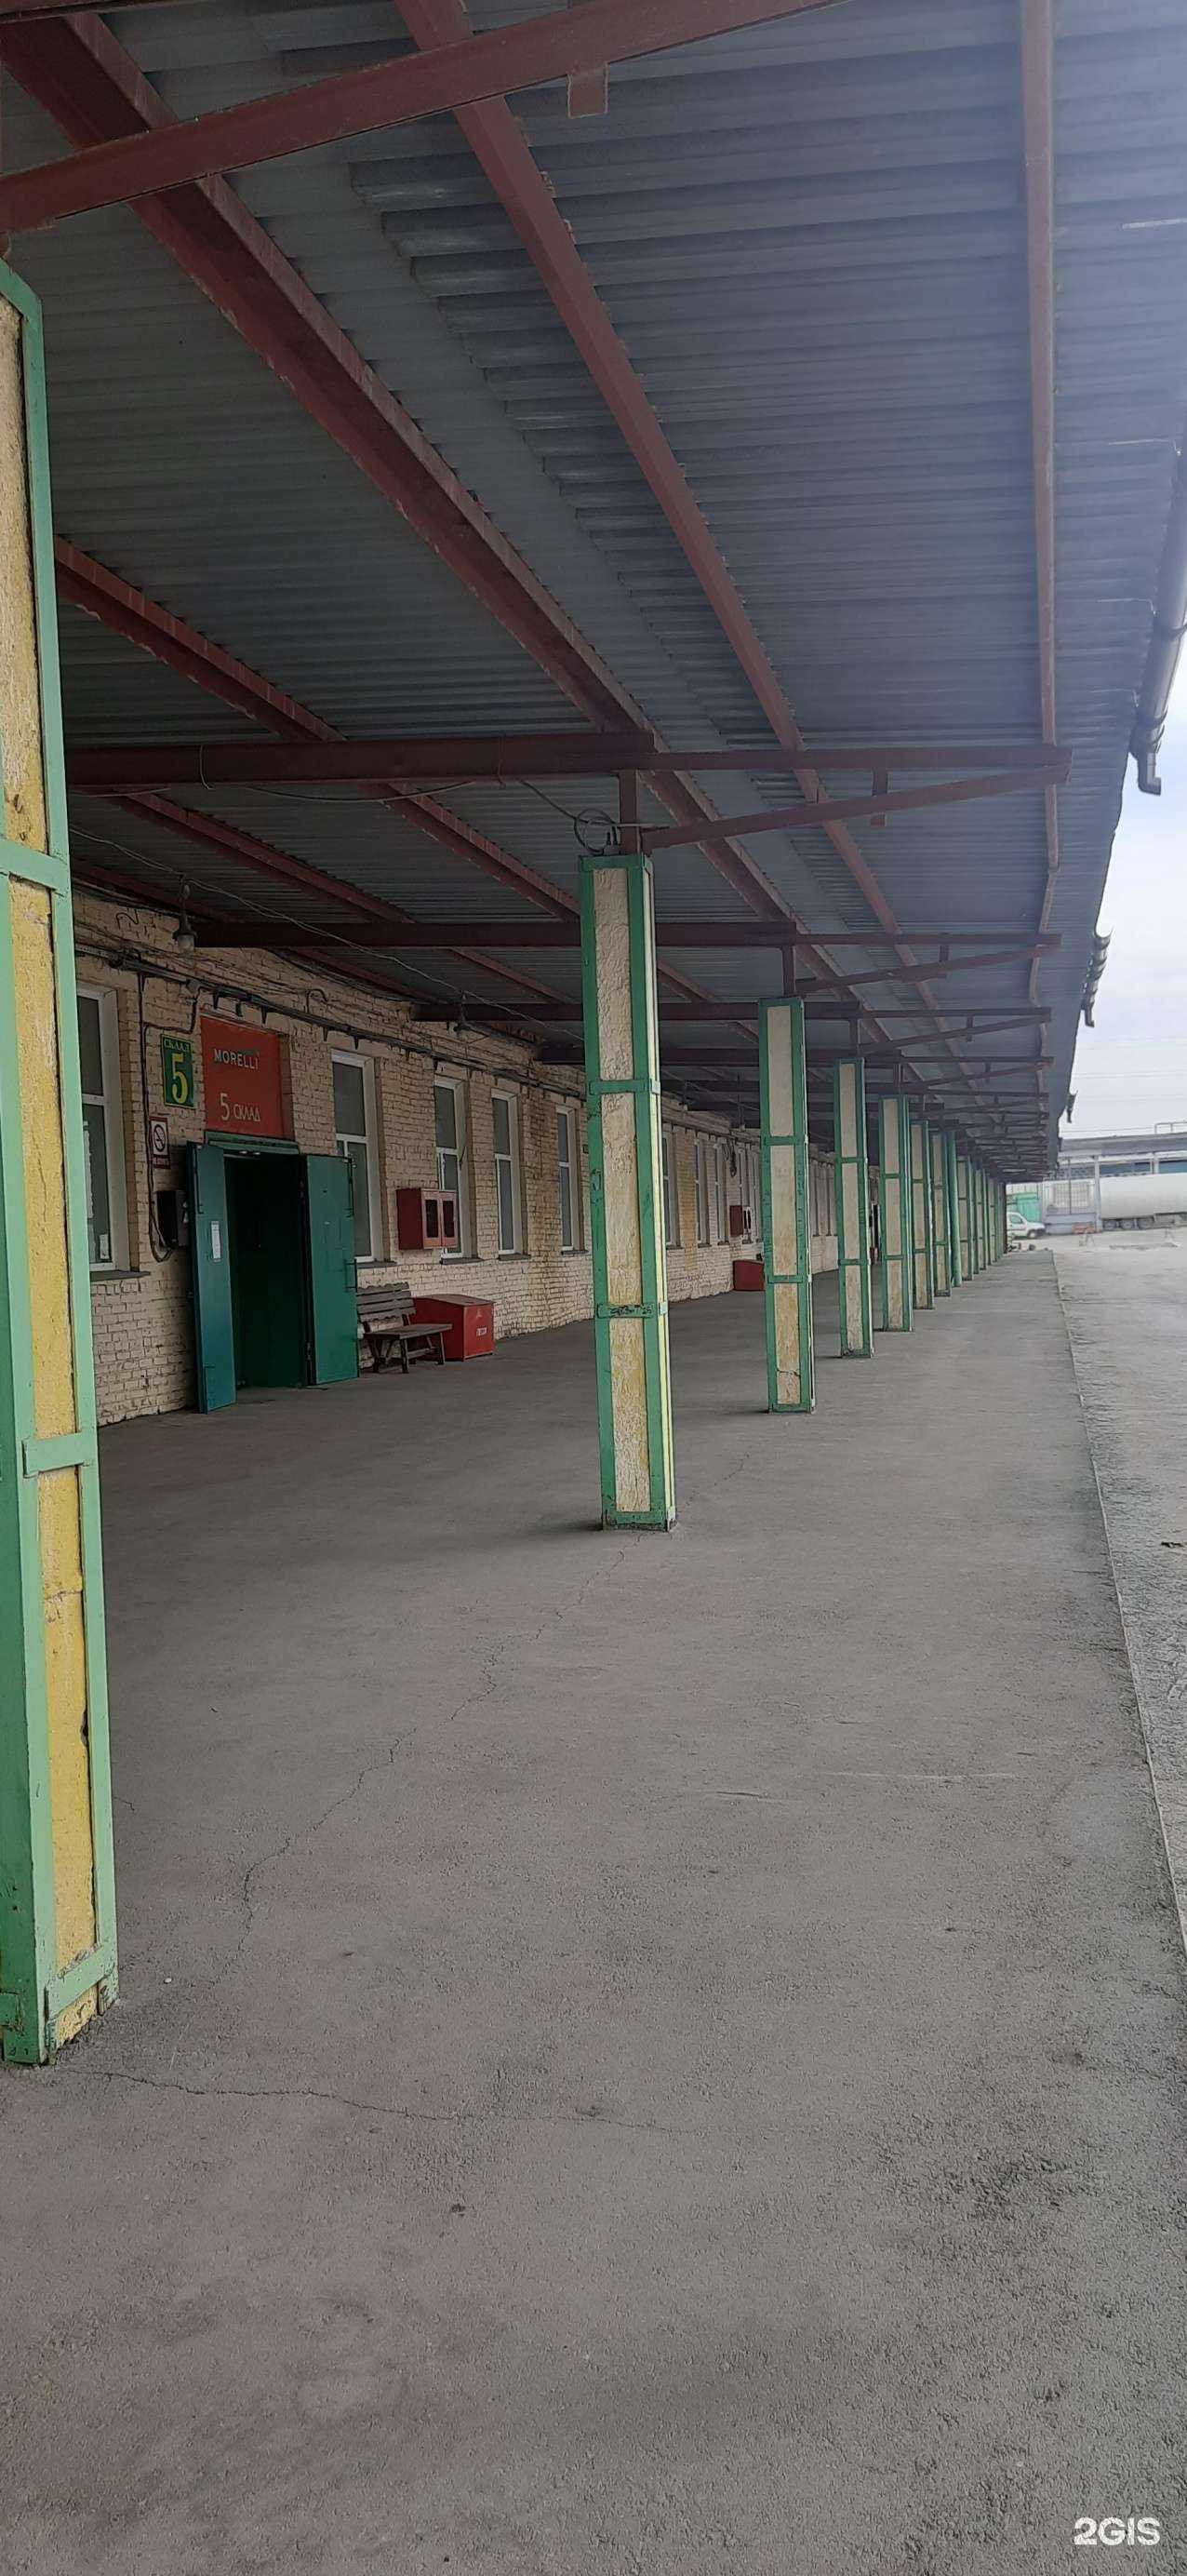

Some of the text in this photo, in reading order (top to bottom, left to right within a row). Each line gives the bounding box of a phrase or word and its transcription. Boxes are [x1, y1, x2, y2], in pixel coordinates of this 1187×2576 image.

[213, 1048, 260, 1070] MORELLI
[171, 1053, 189, 1105] 5
[220, 1093, 261, 1122] 5 СКЛАД
